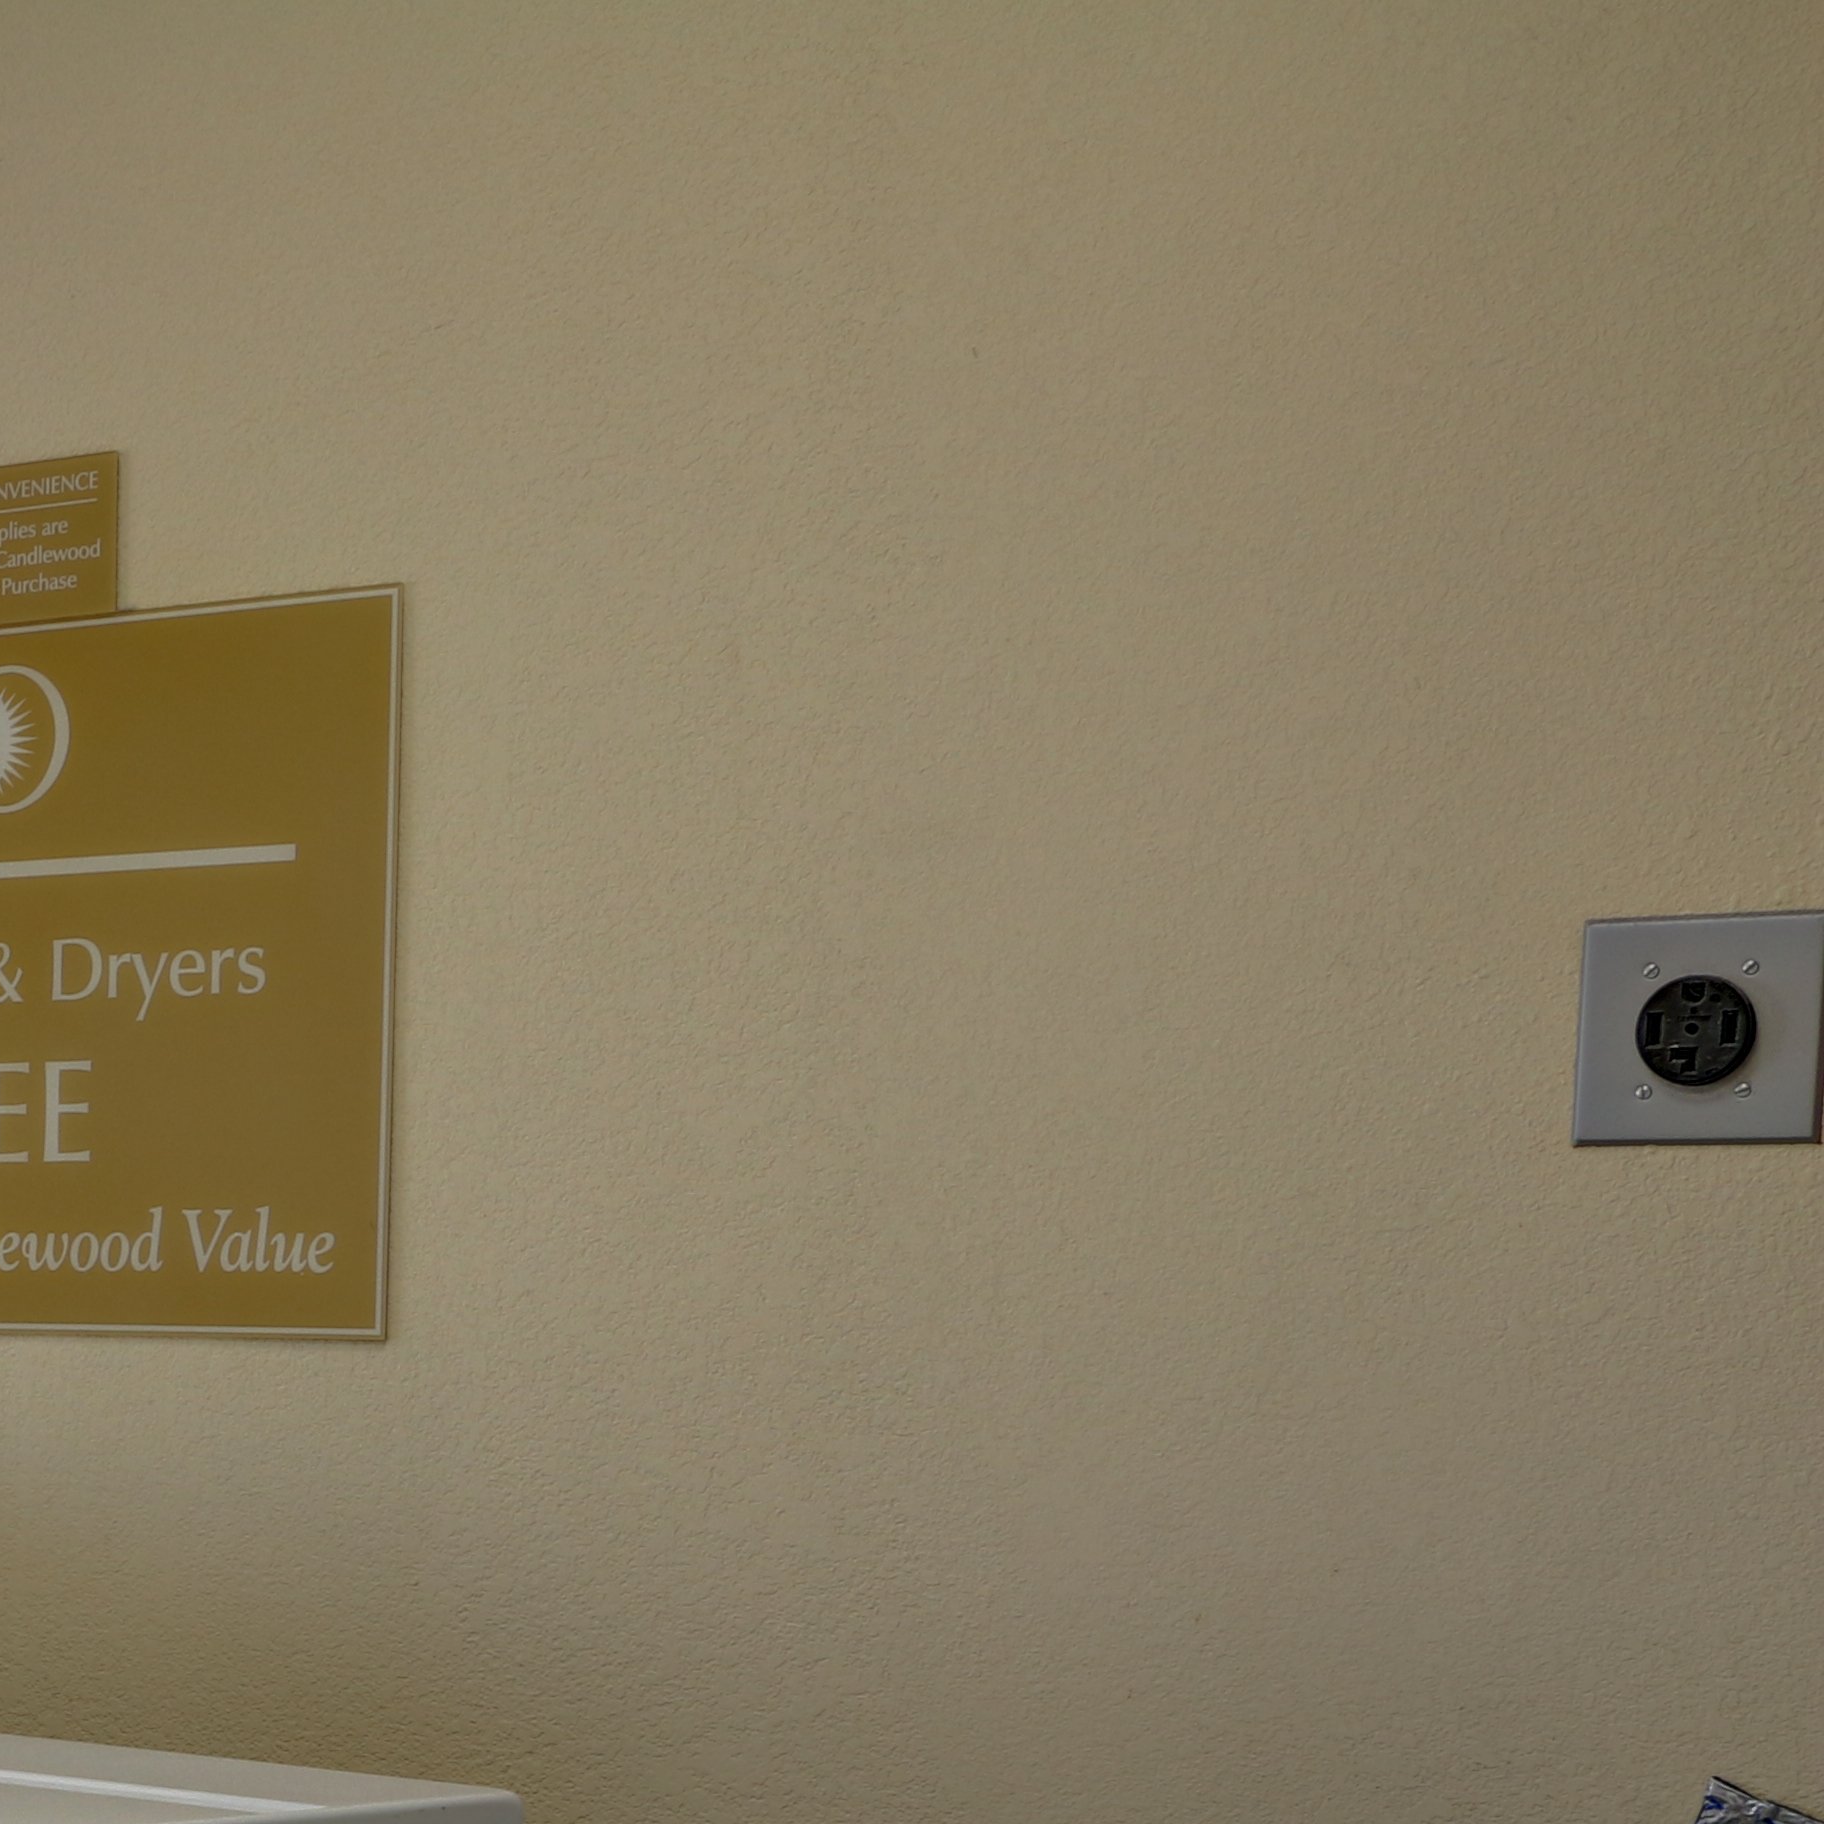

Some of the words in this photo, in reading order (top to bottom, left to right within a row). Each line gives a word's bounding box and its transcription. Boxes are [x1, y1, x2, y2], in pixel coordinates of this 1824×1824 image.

[42, 520, 68, 535] are
[2, 572, 78, 595] Purchase
[51, 937, 266, 1021] Dryers
[182, 1205, 335, 1275] Value
